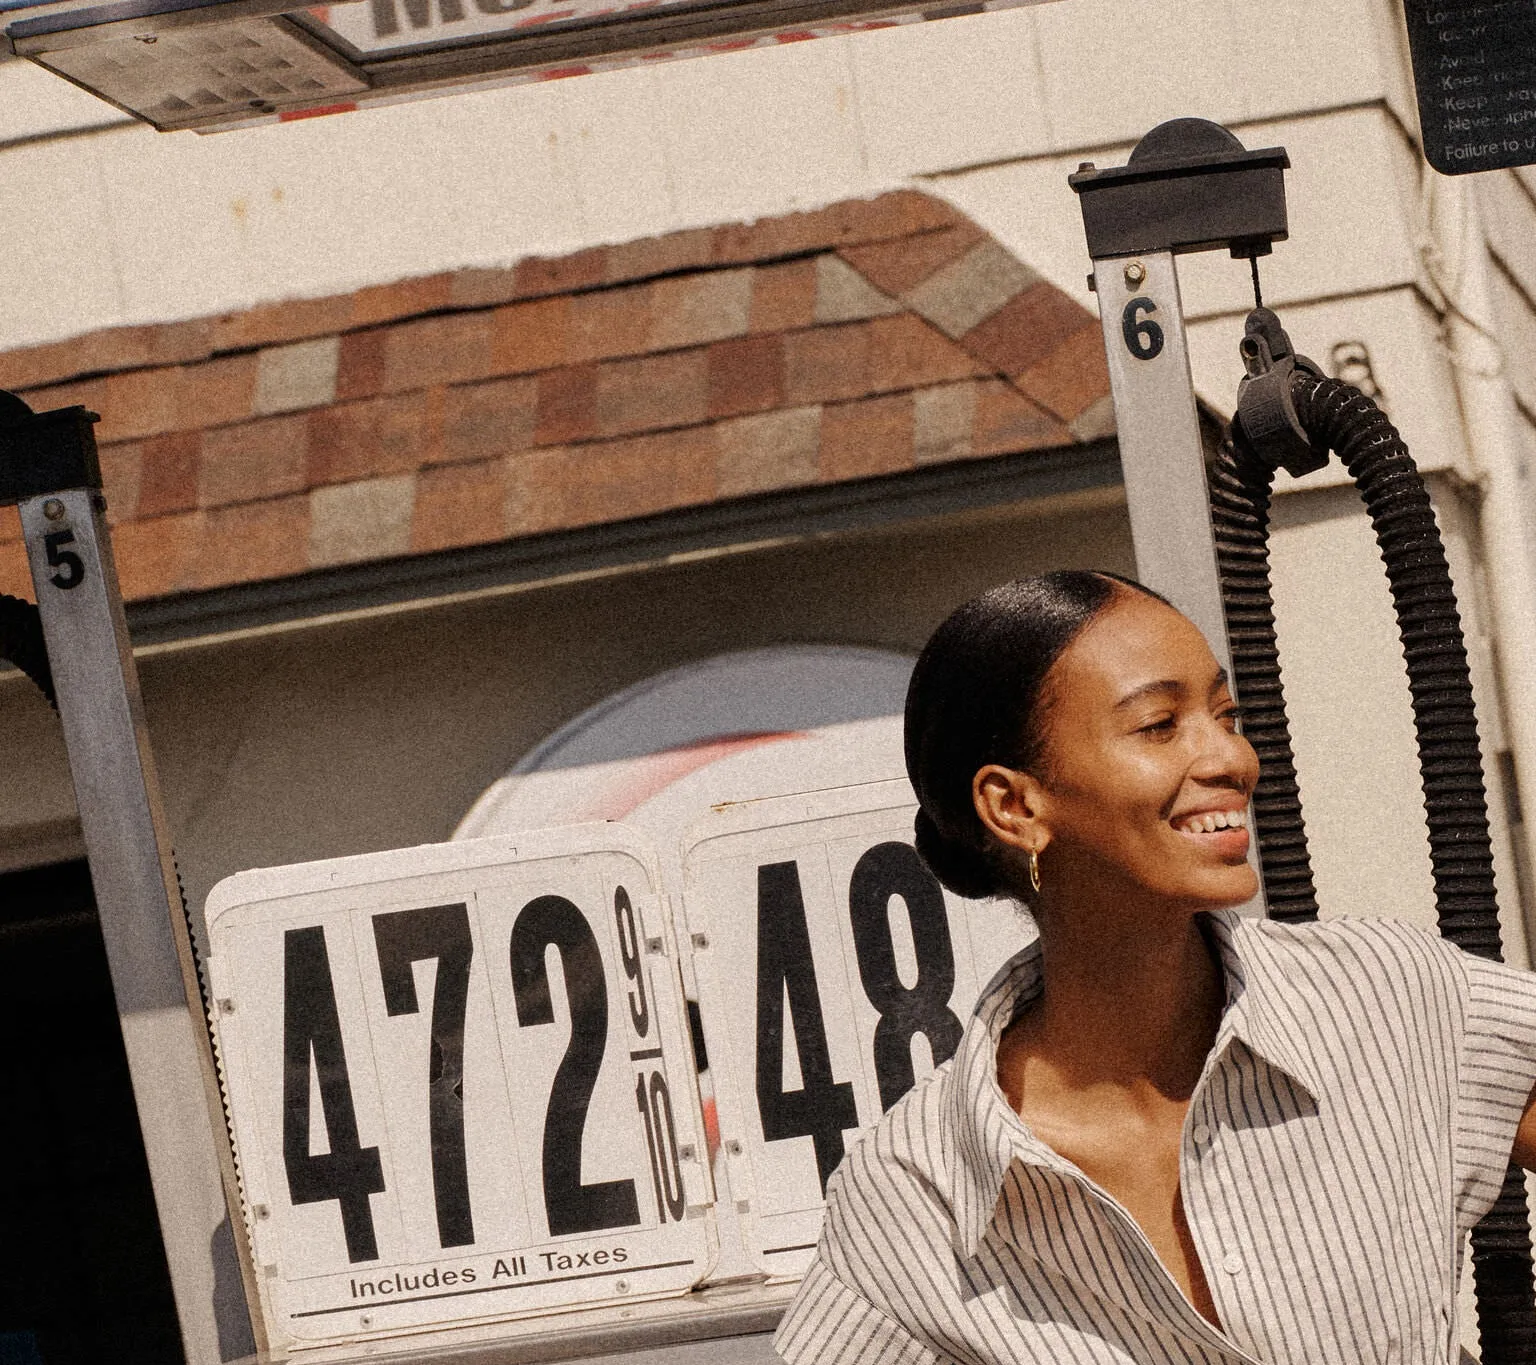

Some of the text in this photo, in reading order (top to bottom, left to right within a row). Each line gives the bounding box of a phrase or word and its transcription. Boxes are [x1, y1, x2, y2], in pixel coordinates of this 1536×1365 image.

[1445, 142, 1499, 160] Failure
[1502, 139, 1519, 152] to
[1122, 296, 1165, 361] 6
[43, 531, 85, 590] 5
[283, 894, 641, 1264] 472
[350, 1247, 628, 1298] Includes All Taxes
